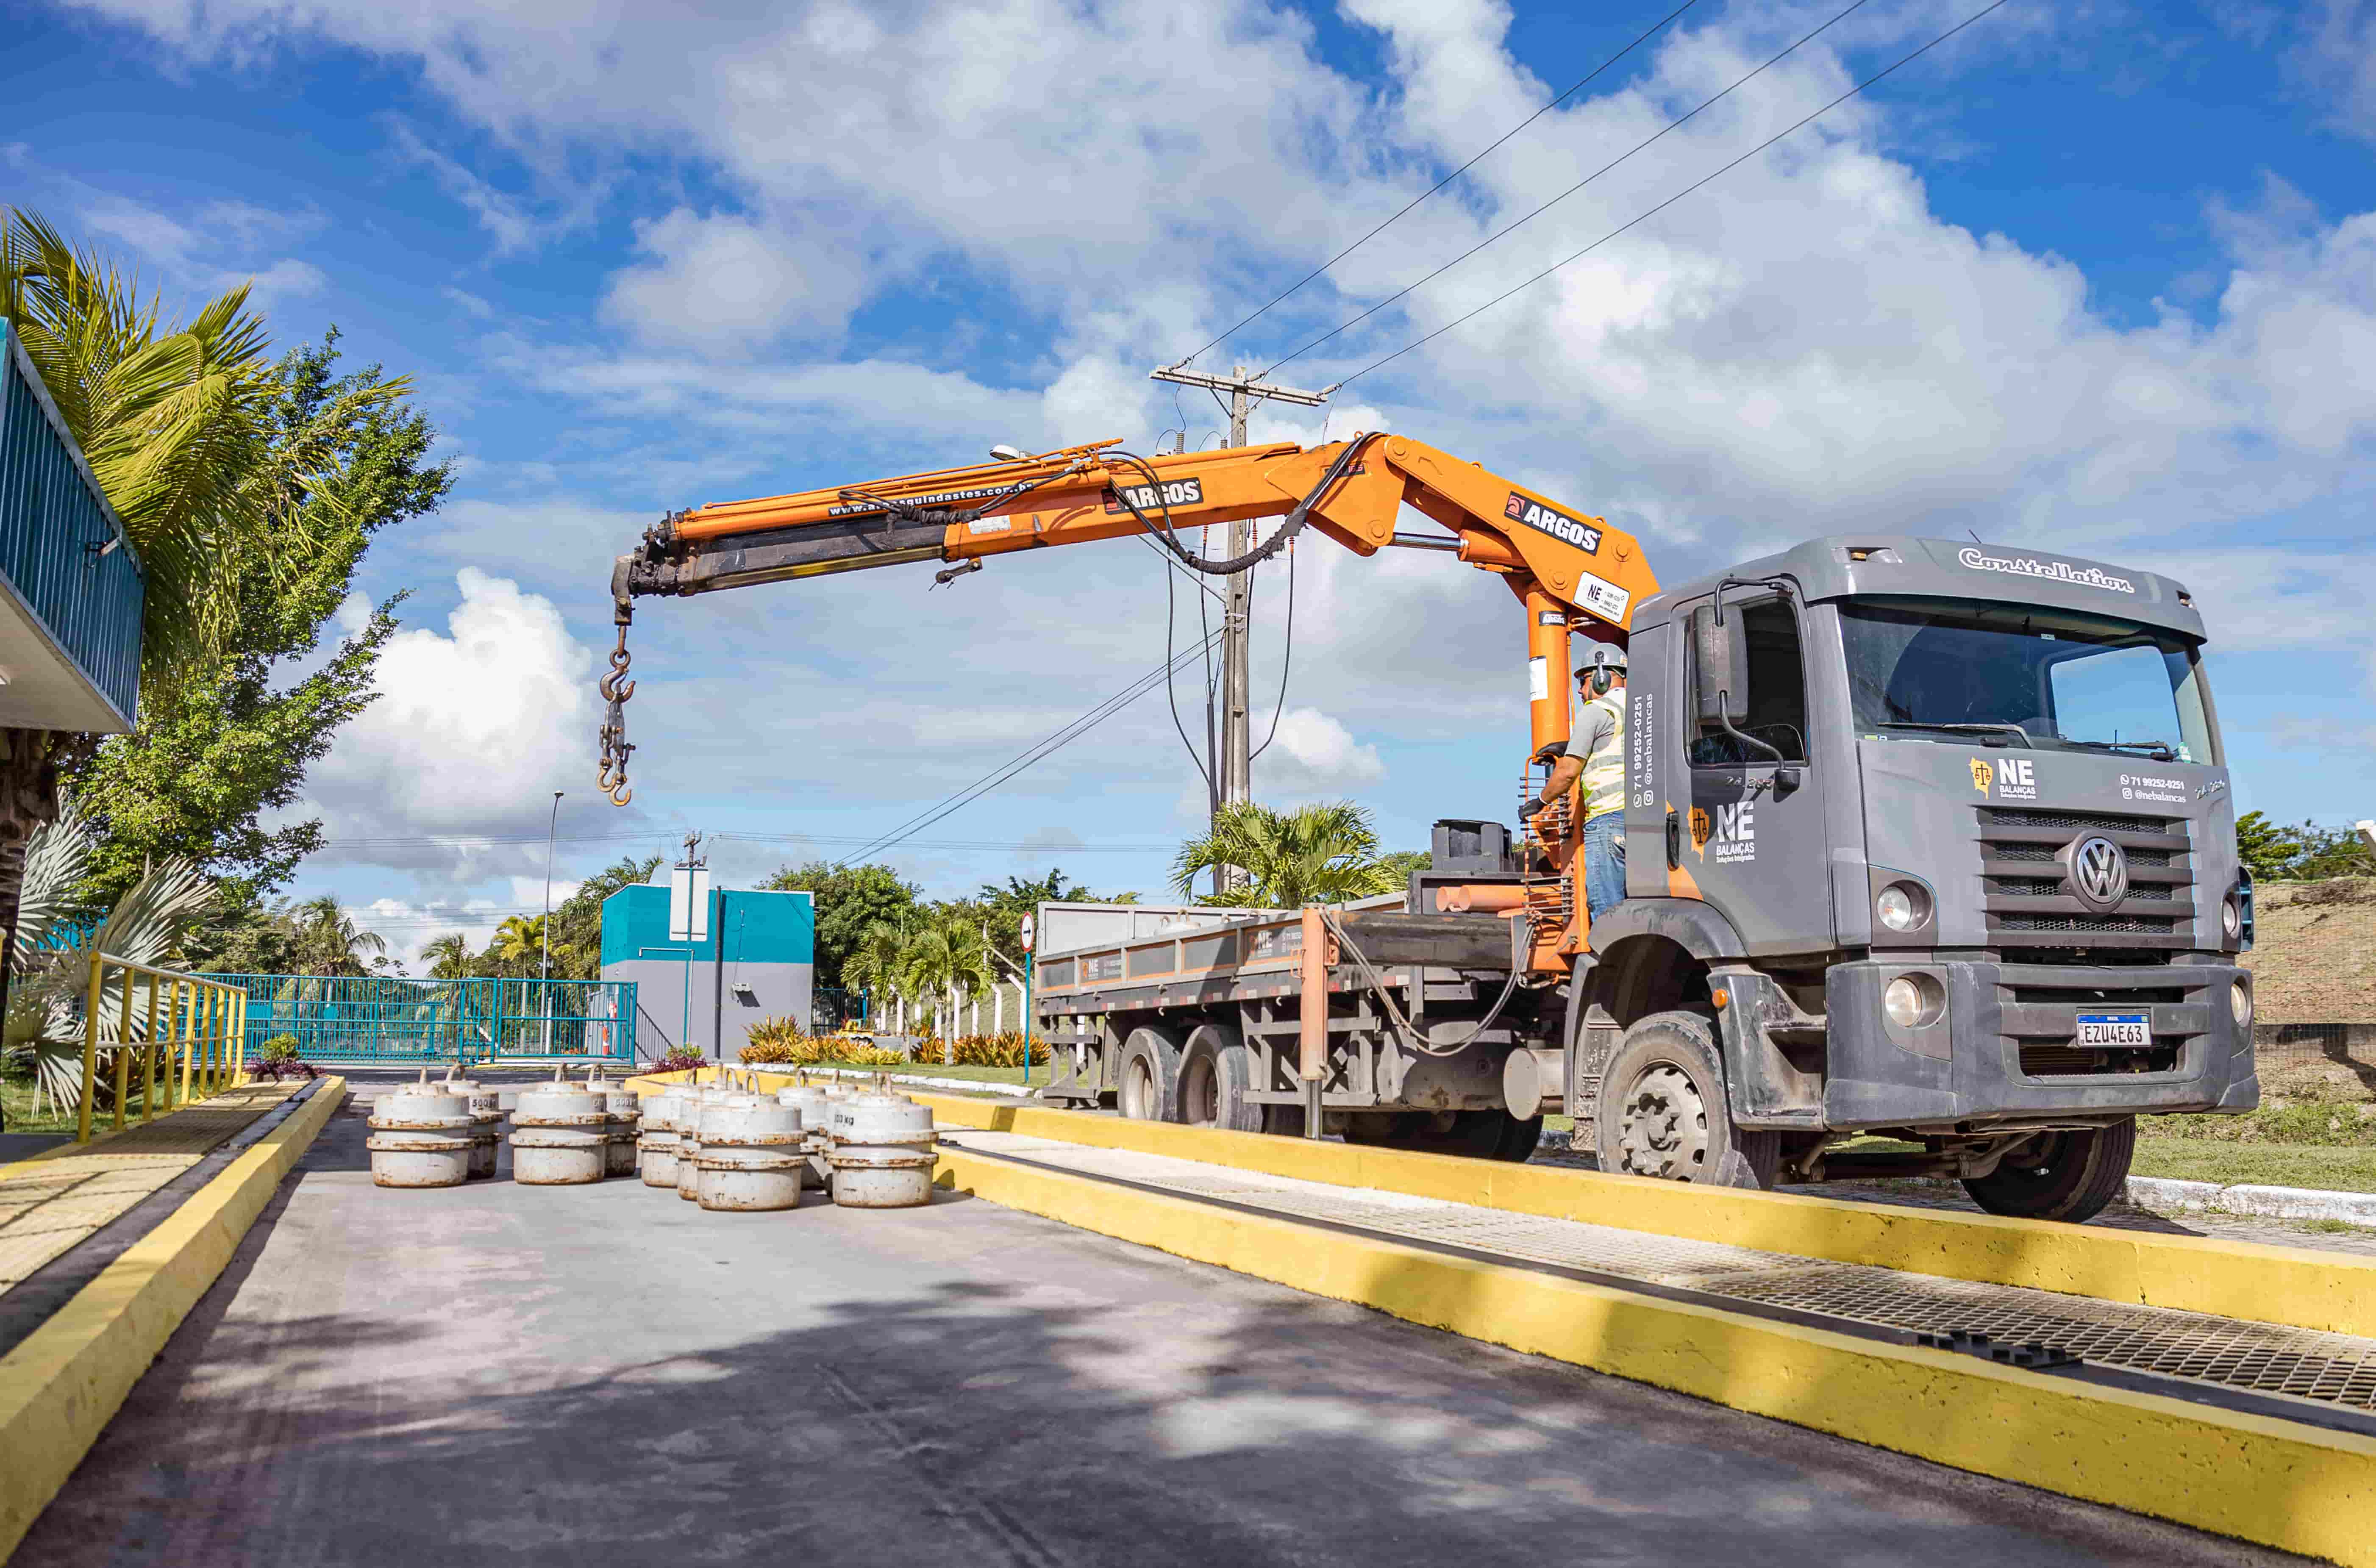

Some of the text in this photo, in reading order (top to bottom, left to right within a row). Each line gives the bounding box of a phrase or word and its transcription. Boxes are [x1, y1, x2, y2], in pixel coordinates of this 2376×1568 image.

[1523, 504, 1598, 551] ARGOS
[1959, 548, 2135, 593] Constellation
[1588, 584, 1602, 601] NE
[1634, 695, 1642, 790] 71 99252-0251
[1644, 693, 1653, 785] @nebalancas
[1997, 758, 2034, 785] NE
[2131, 776, 2185, 790] 71 99252-0251
[2135, 790, 2187, 803] @nebalancas
[1717, 800, 1754, 842] NE
[1717, 842, 1754, 856] BALANÇAS
[2084, 1025, 2142, 1043] EZU4E63
